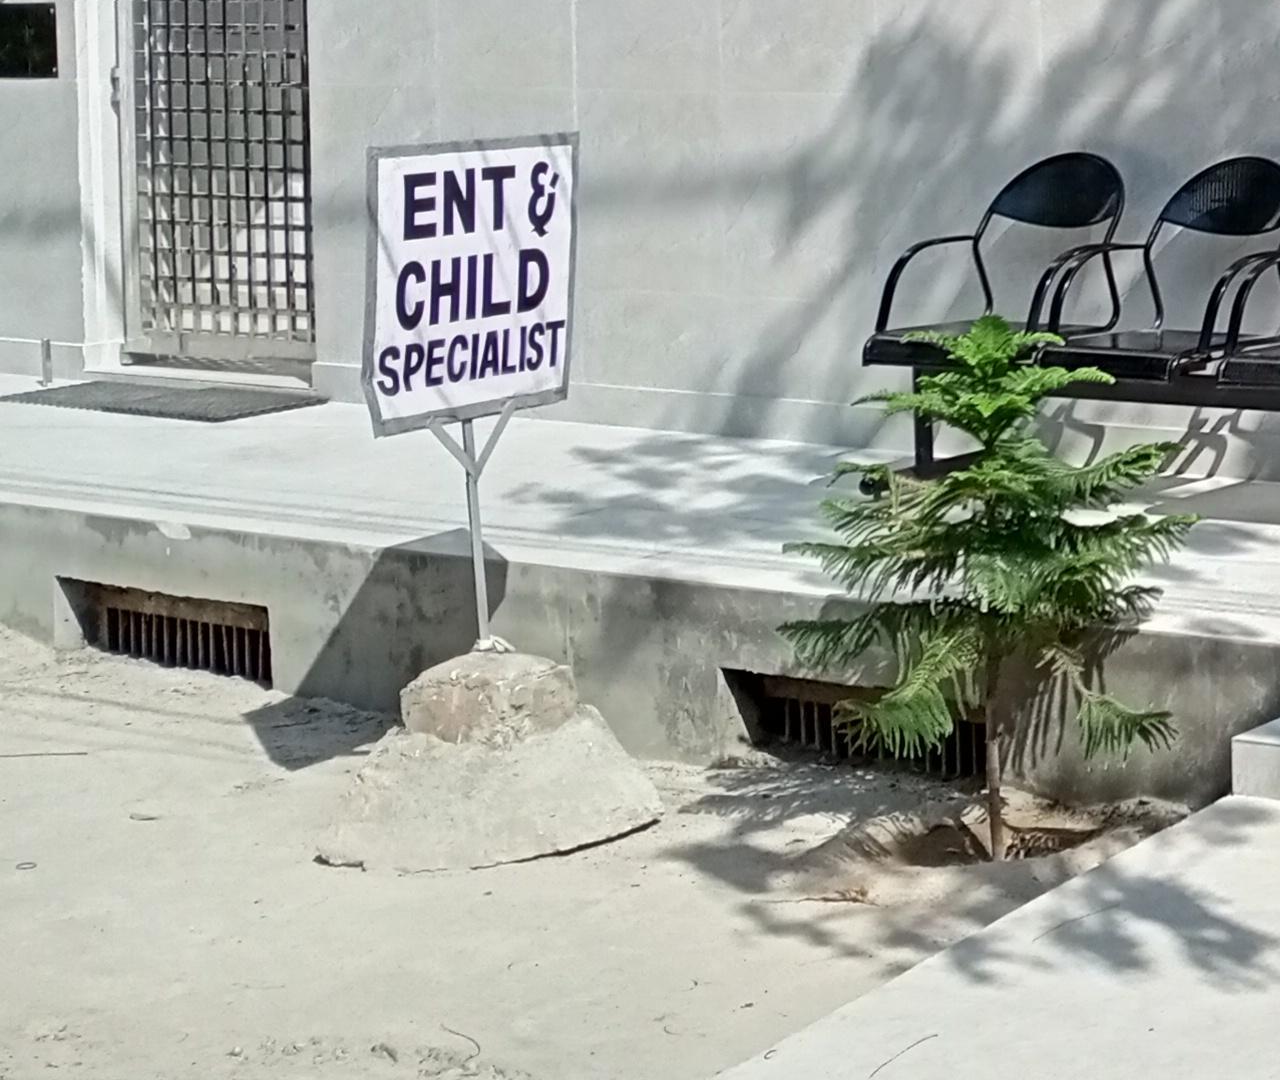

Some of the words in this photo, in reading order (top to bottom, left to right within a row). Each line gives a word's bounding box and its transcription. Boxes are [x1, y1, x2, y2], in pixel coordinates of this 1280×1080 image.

[403, 165, 516, 241] ENT
[527, 161, 560, 238] &
[395, 248, 550, 331] CHILD
[376, 320, 566, 397] SPECIALIST
